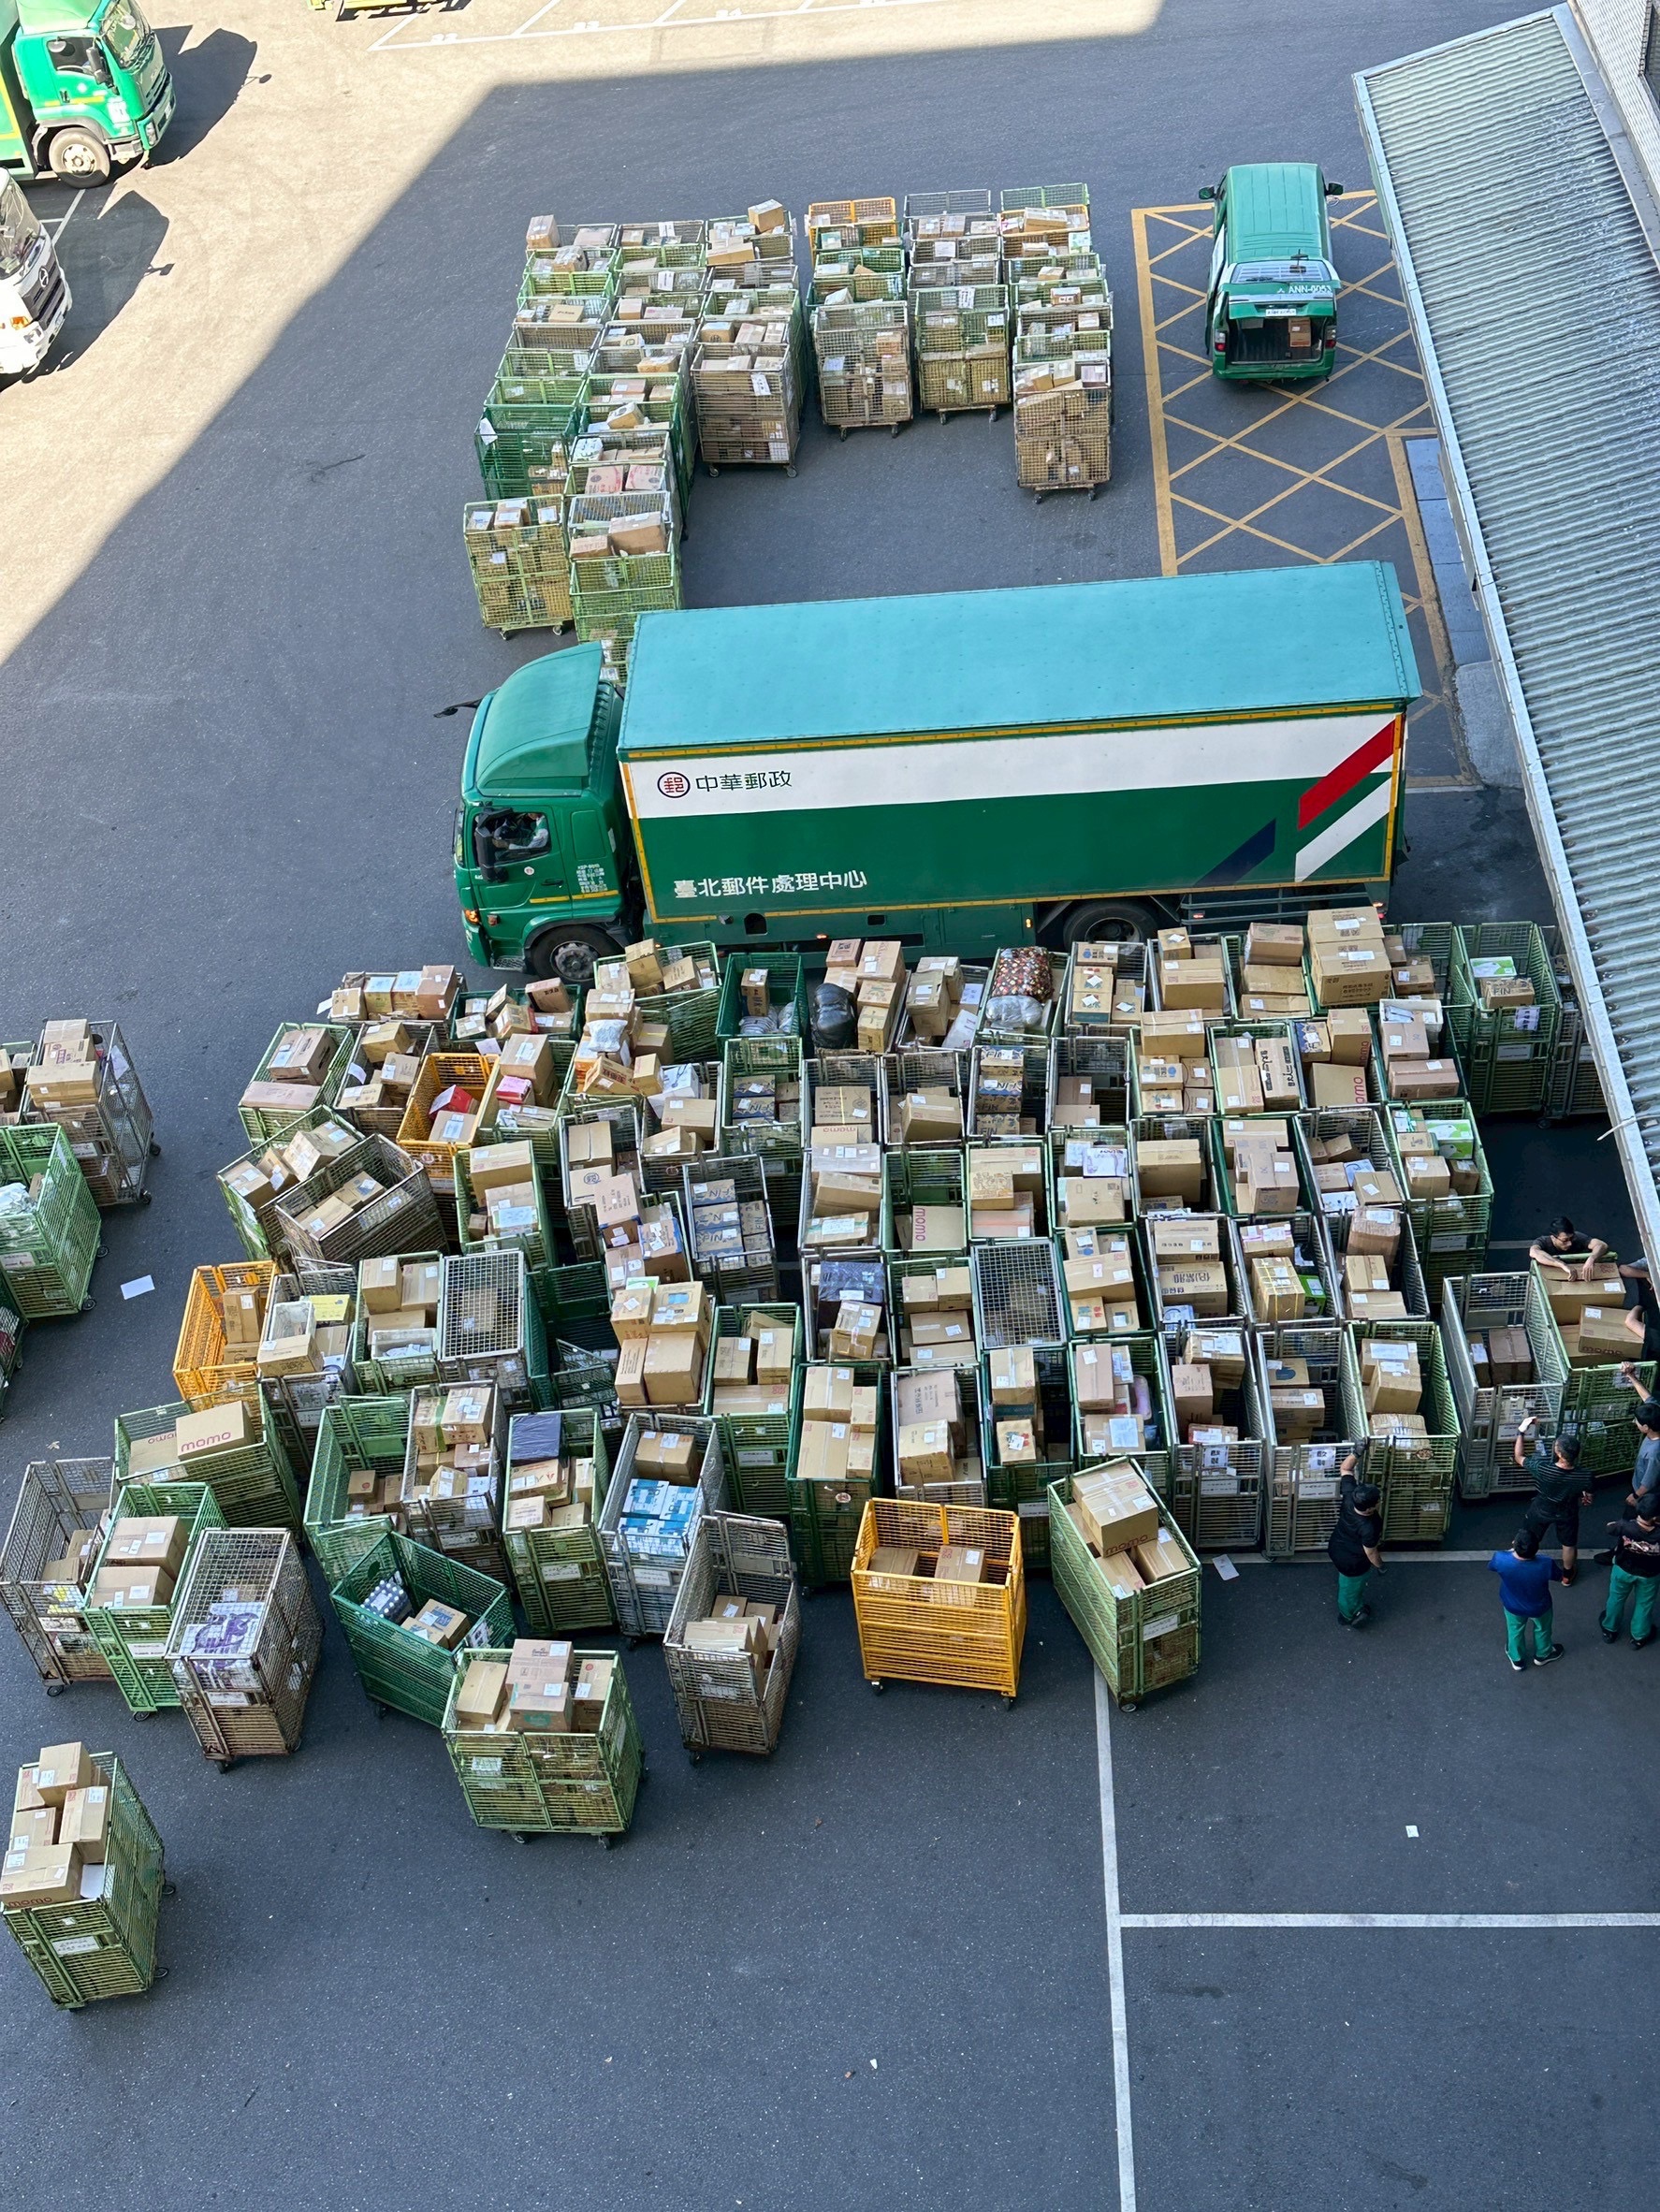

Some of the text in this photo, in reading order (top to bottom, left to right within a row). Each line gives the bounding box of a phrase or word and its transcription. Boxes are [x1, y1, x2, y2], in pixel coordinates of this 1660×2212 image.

[695, 770, 793, 793] 中華郵政
[674, 869, 868, 898] 臺北郵件處理中心
[1359, 1041, 1370, 1066] omo
[1353, 1076, 1365, 1104] omo
[914, 1207, 926, 1242] momo
[148, 1431, 177, 1445] omo
[181, 1432, 232, 1452] momo
[1105, 1535, 1148, 1555] momo
[8, 1897, 52, 1908] momo
